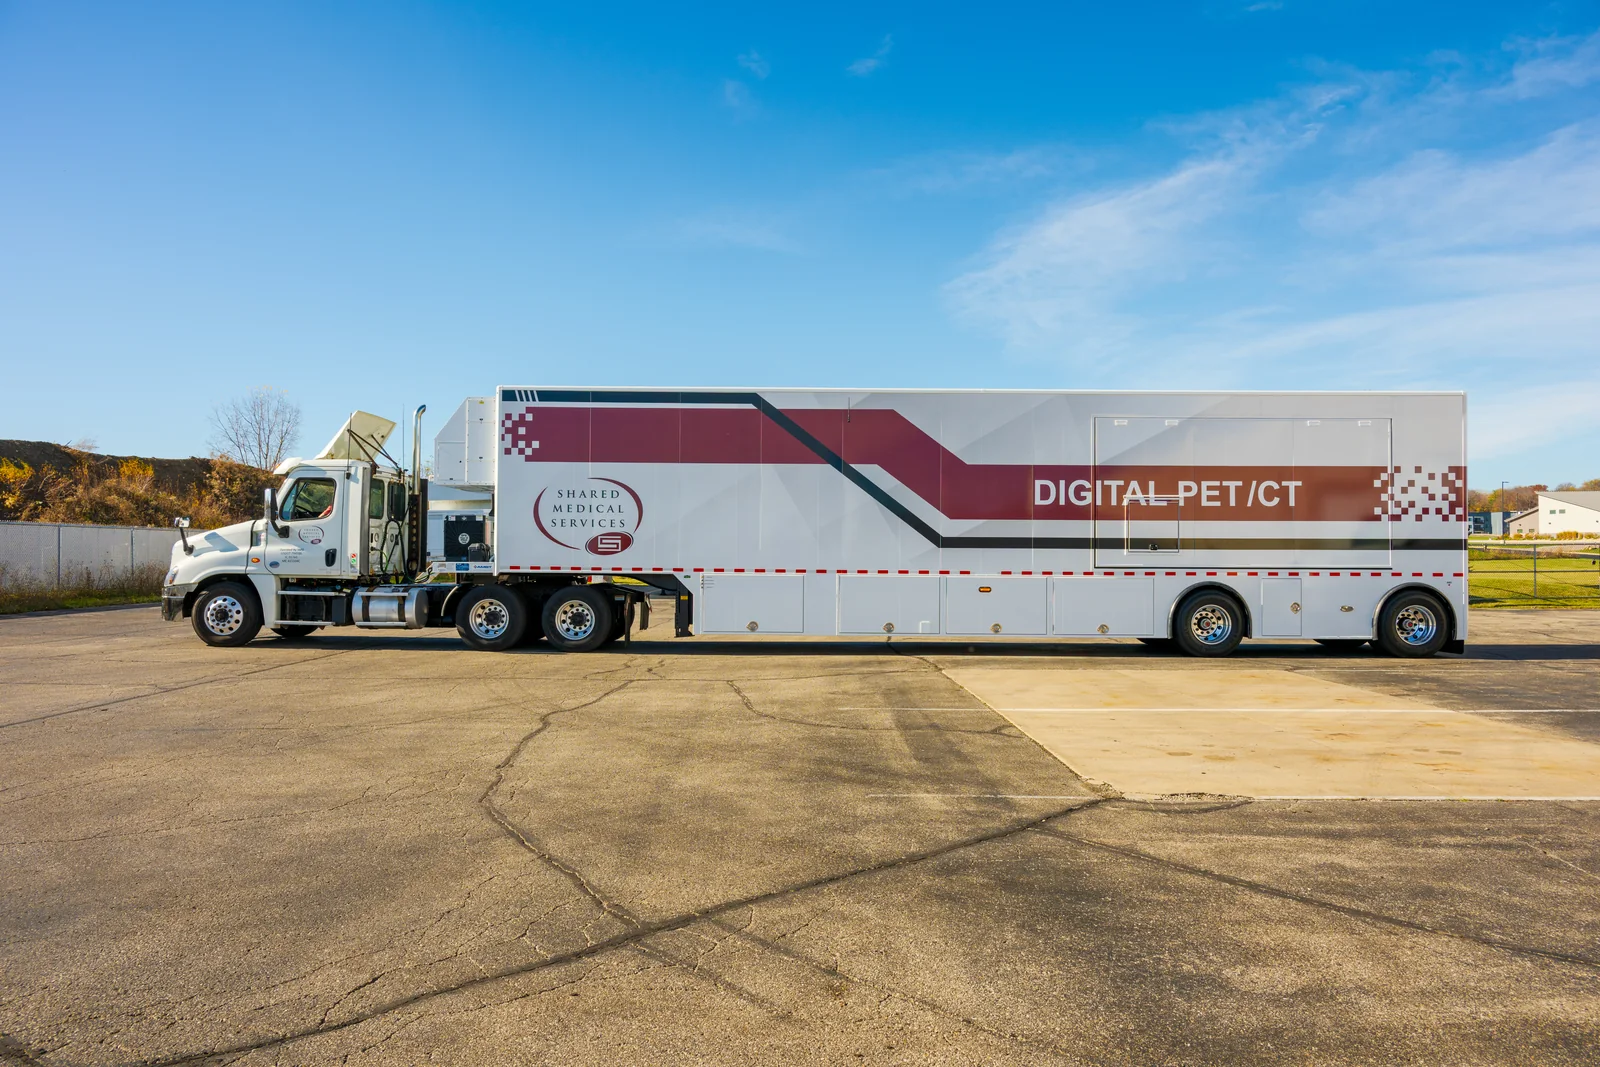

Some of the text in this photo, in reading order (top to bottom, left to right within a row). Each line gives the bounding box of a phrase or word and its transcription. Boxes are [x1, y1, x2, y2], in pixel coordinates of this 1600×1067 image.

[557, 489, 620, 498] SHARED
[1034, 479, 1167, 506] DIGITAL
[552, 504, 624, 513] MEDICAL
[551, 519, 625, 528] SERVICES
